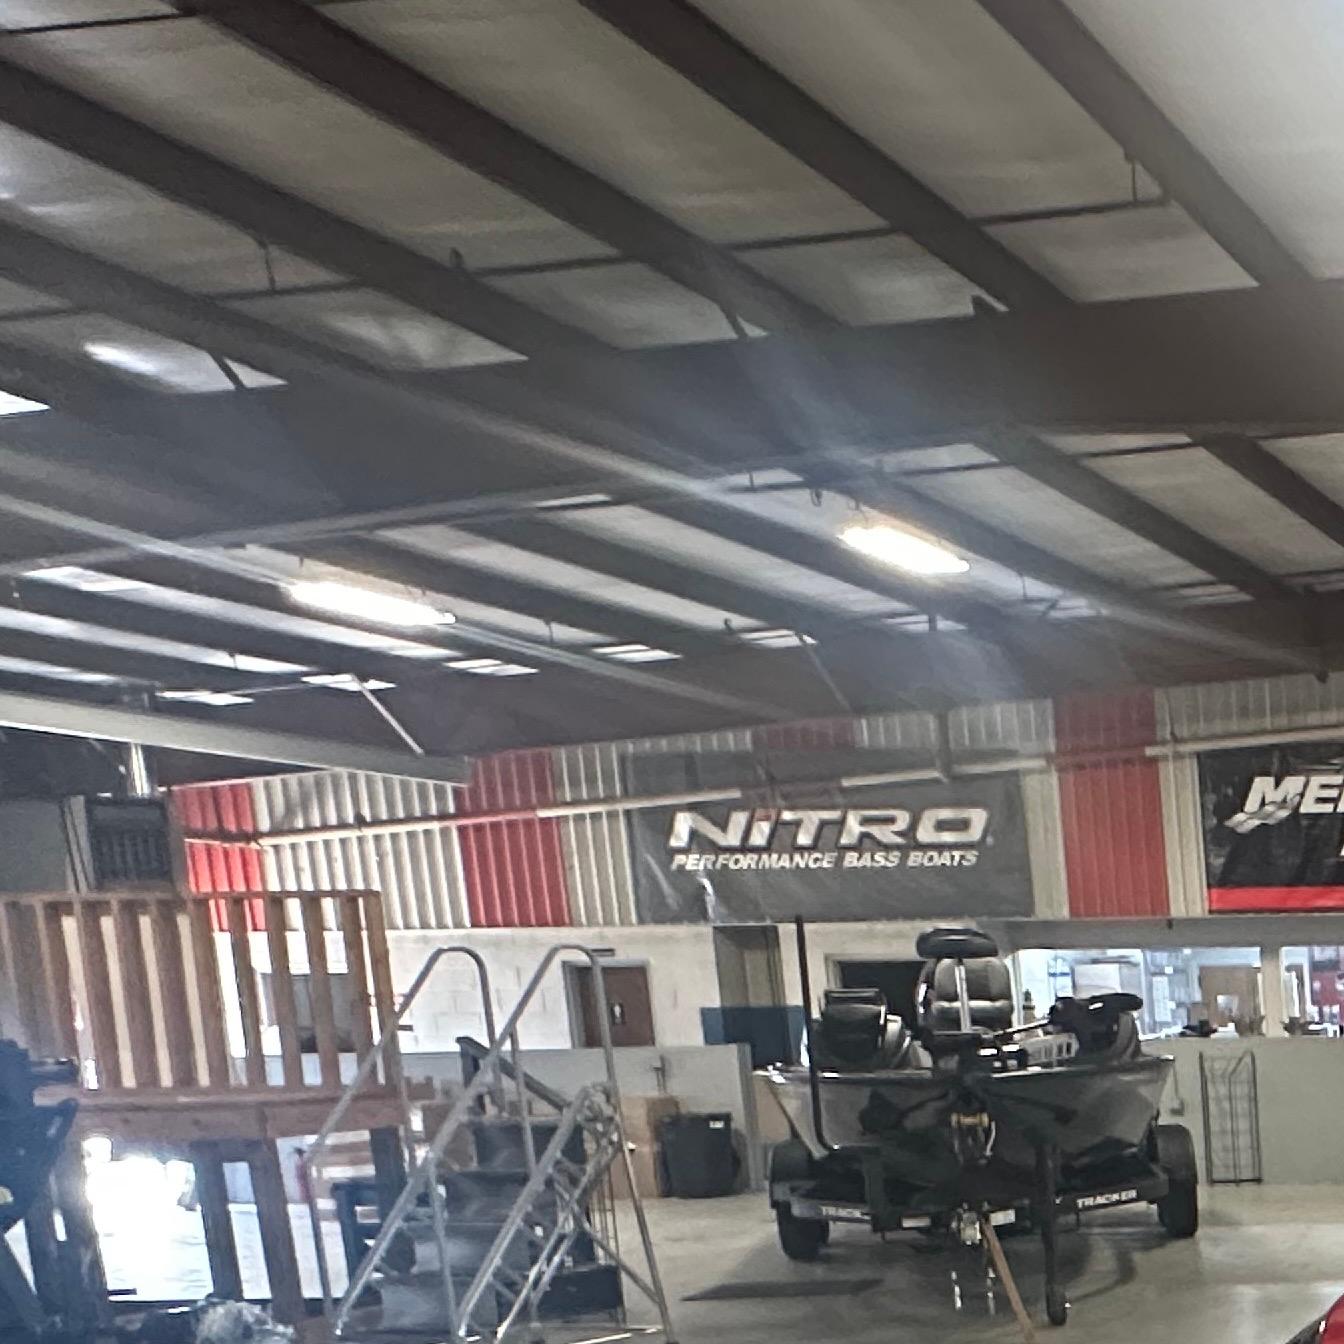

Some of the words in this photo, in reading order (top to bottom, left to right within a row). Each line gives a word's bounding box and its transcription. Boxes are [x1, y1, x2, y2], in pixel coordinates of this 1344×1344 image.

[671, 851, 838, 871] PERFORMANCE
[843, 851, 901, 869] BASS
[907, 850, 979, 868] BOATS
